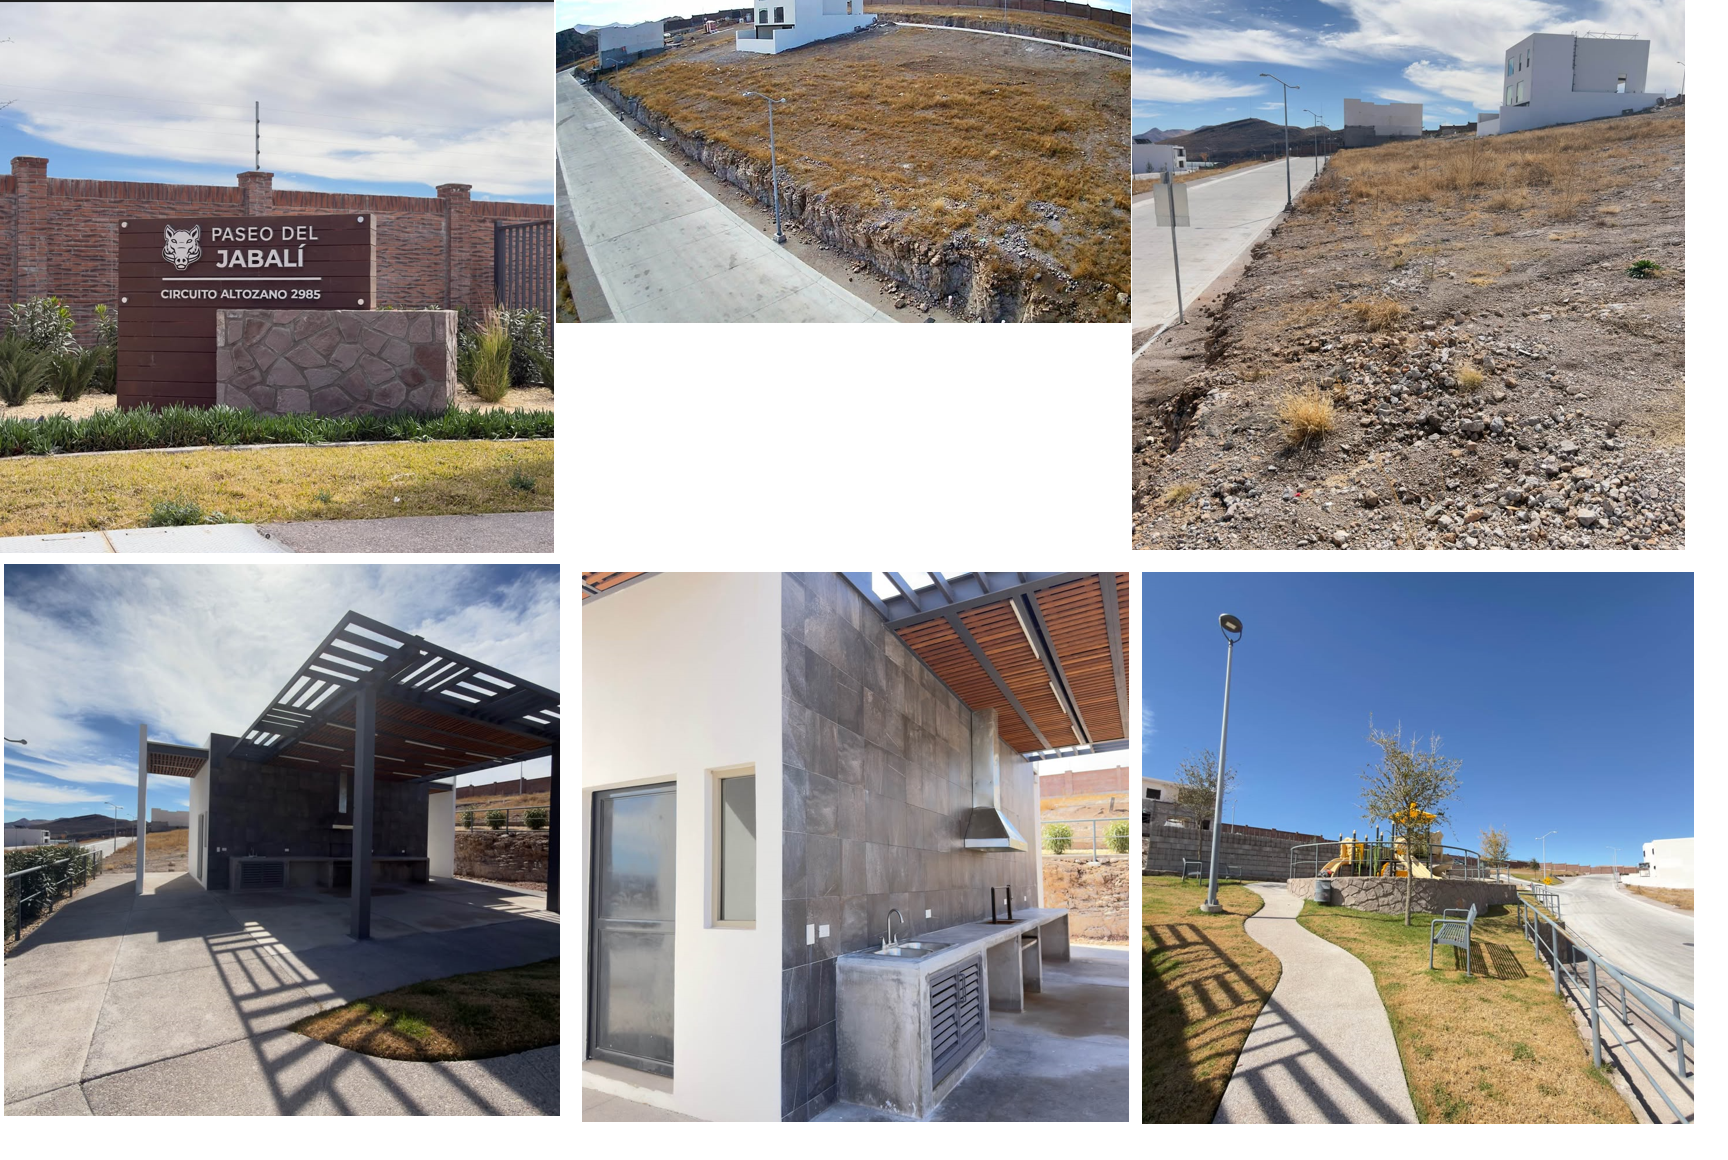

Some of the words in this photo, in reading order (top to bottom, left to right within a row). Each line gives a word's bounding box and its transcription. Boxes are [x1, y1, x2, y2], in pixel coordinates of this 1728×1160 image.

[211, 227, 274, 242] PASEO
[281, 226, 319, 241] DEL
[216, 243, 306, 268] JABALÍ
[160, 289, 217, 299] CIRCUITO
[220, 289, 288, 299] ALTOZANO
[290, 289, 321, 300] 2985
